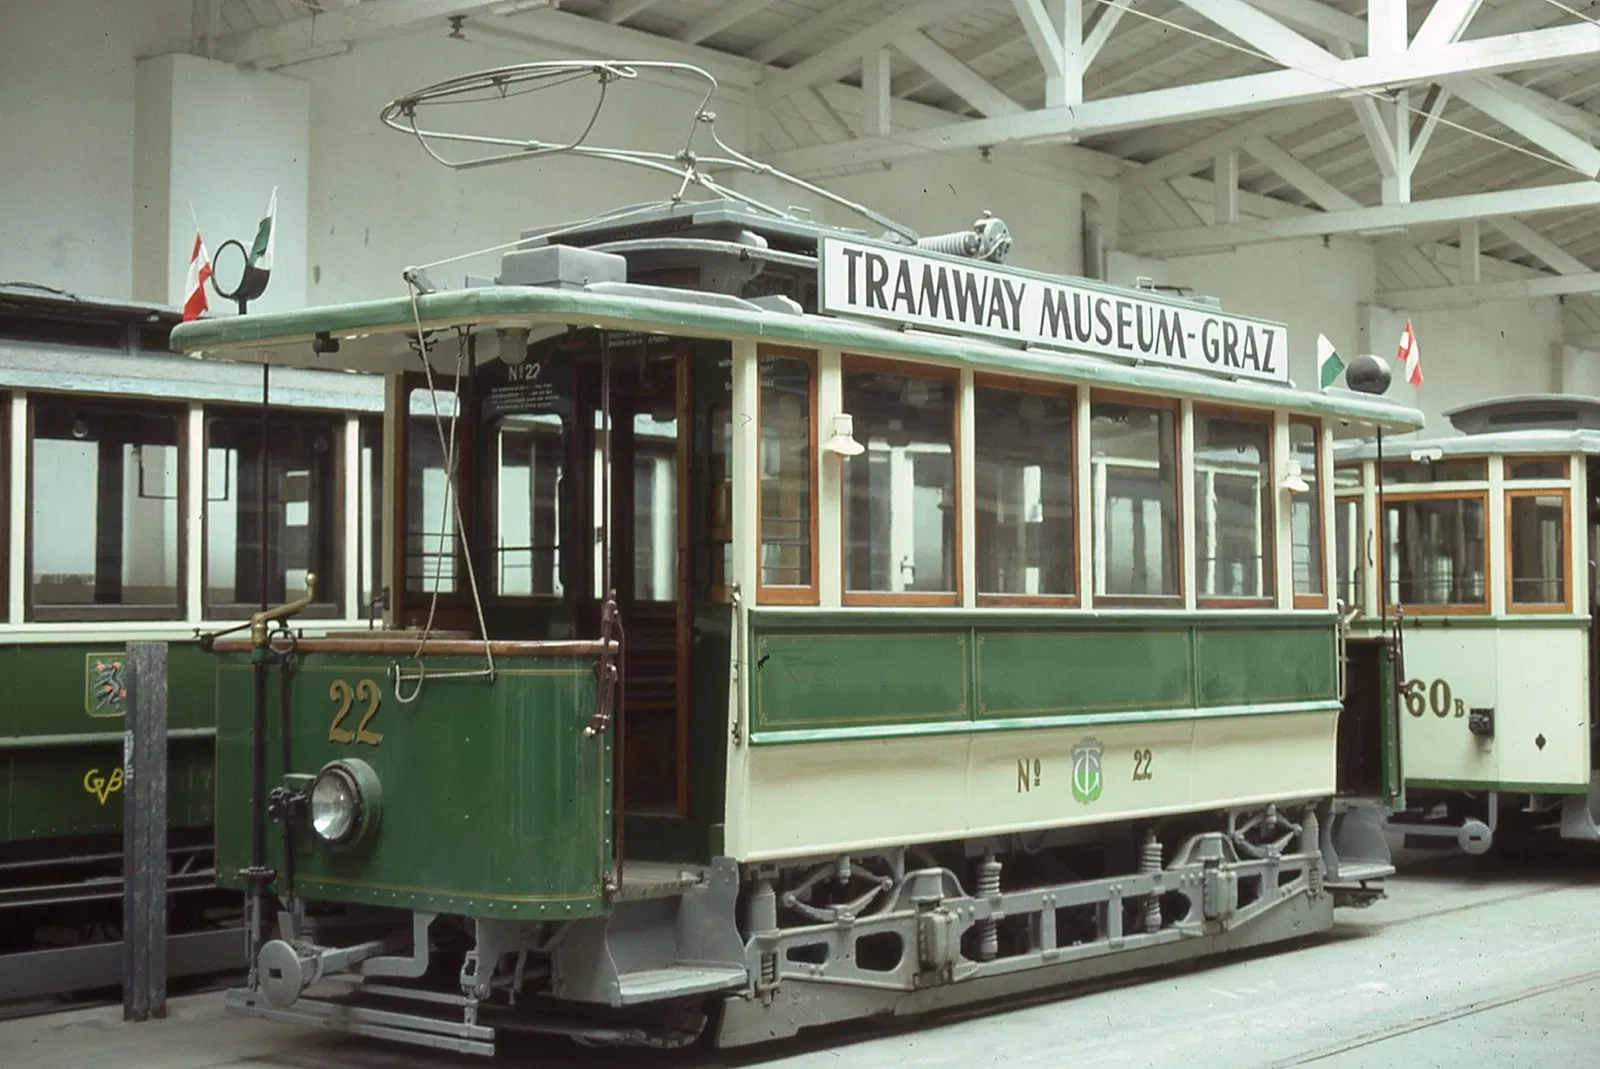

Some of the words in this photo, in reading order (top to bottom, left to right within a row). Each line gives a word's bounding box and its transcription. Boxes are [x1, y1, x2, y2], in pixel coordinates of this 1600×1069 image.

[842, 248, 1027, 332] TRAMWAY
[328, 679, 383, 746] 22
[84, 768, 124, 805] GVB
[1133, 749, 1152, 781] 22
